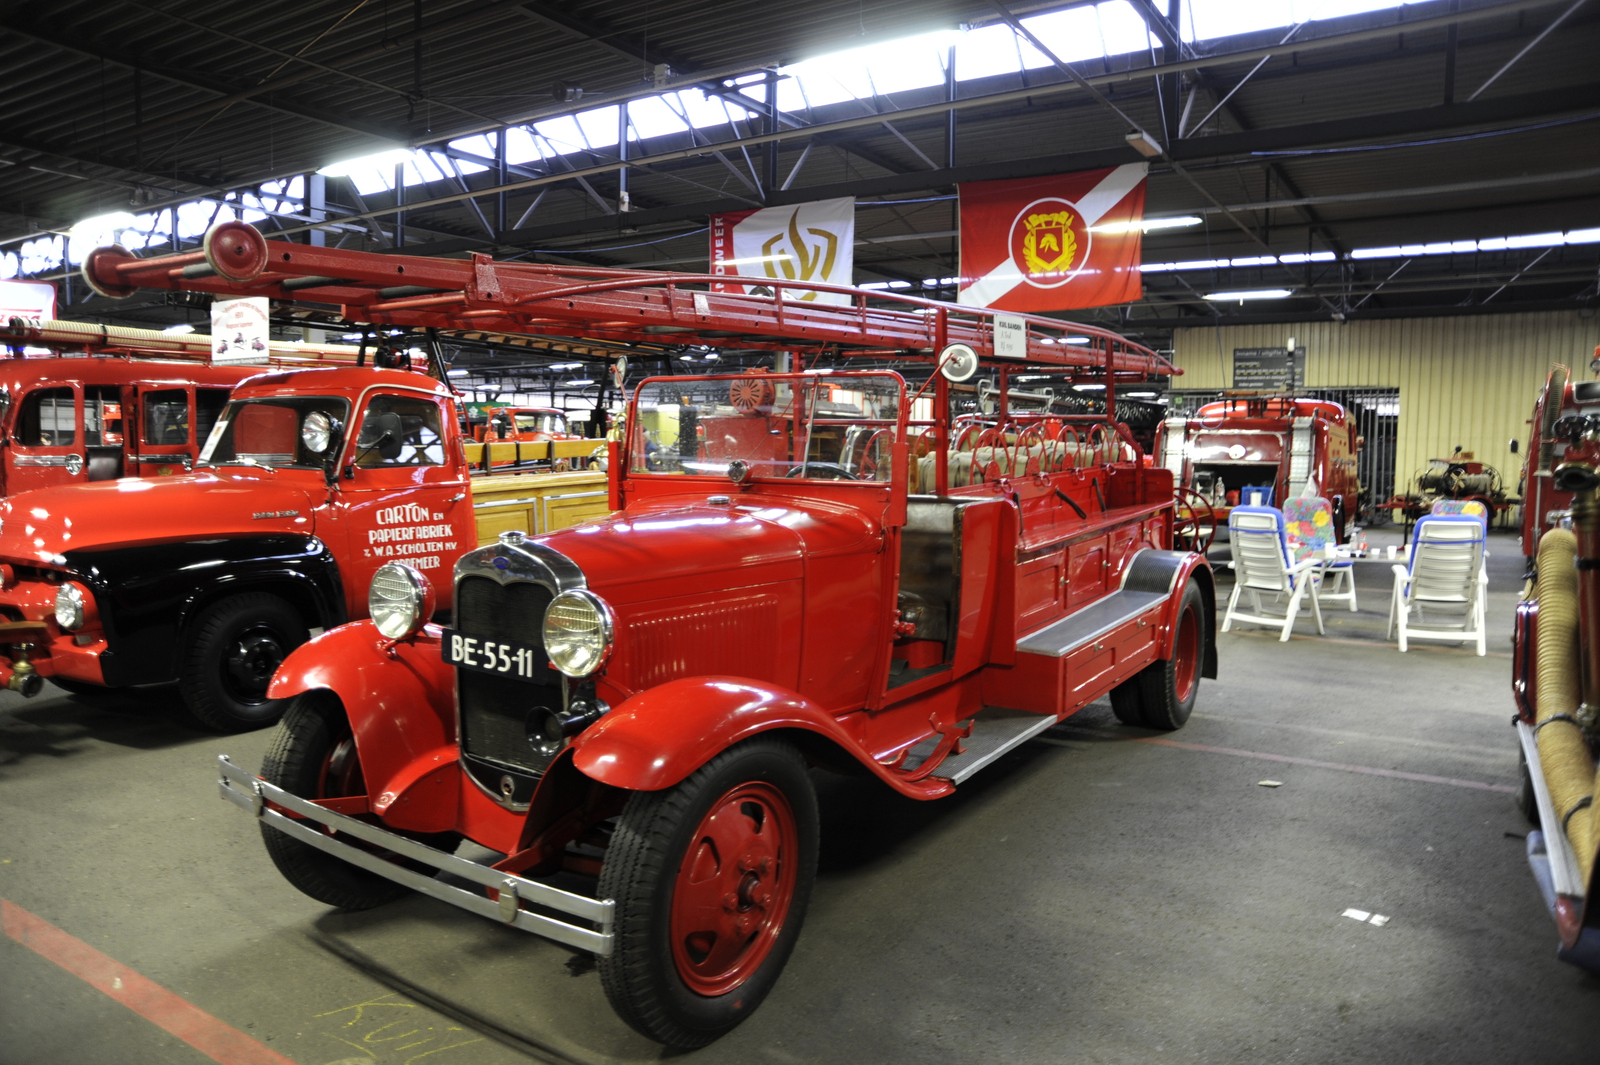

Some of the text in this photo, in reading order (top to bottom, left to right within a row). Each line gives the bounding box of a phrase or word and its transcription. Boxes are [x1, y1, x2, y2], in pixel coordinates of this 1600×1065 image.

[375, 504, 444, 525] CARTON EN
[368, 524, 453, 544] PAPIERFABRIEK
[451, 635, 533, 678] BE-55-11
